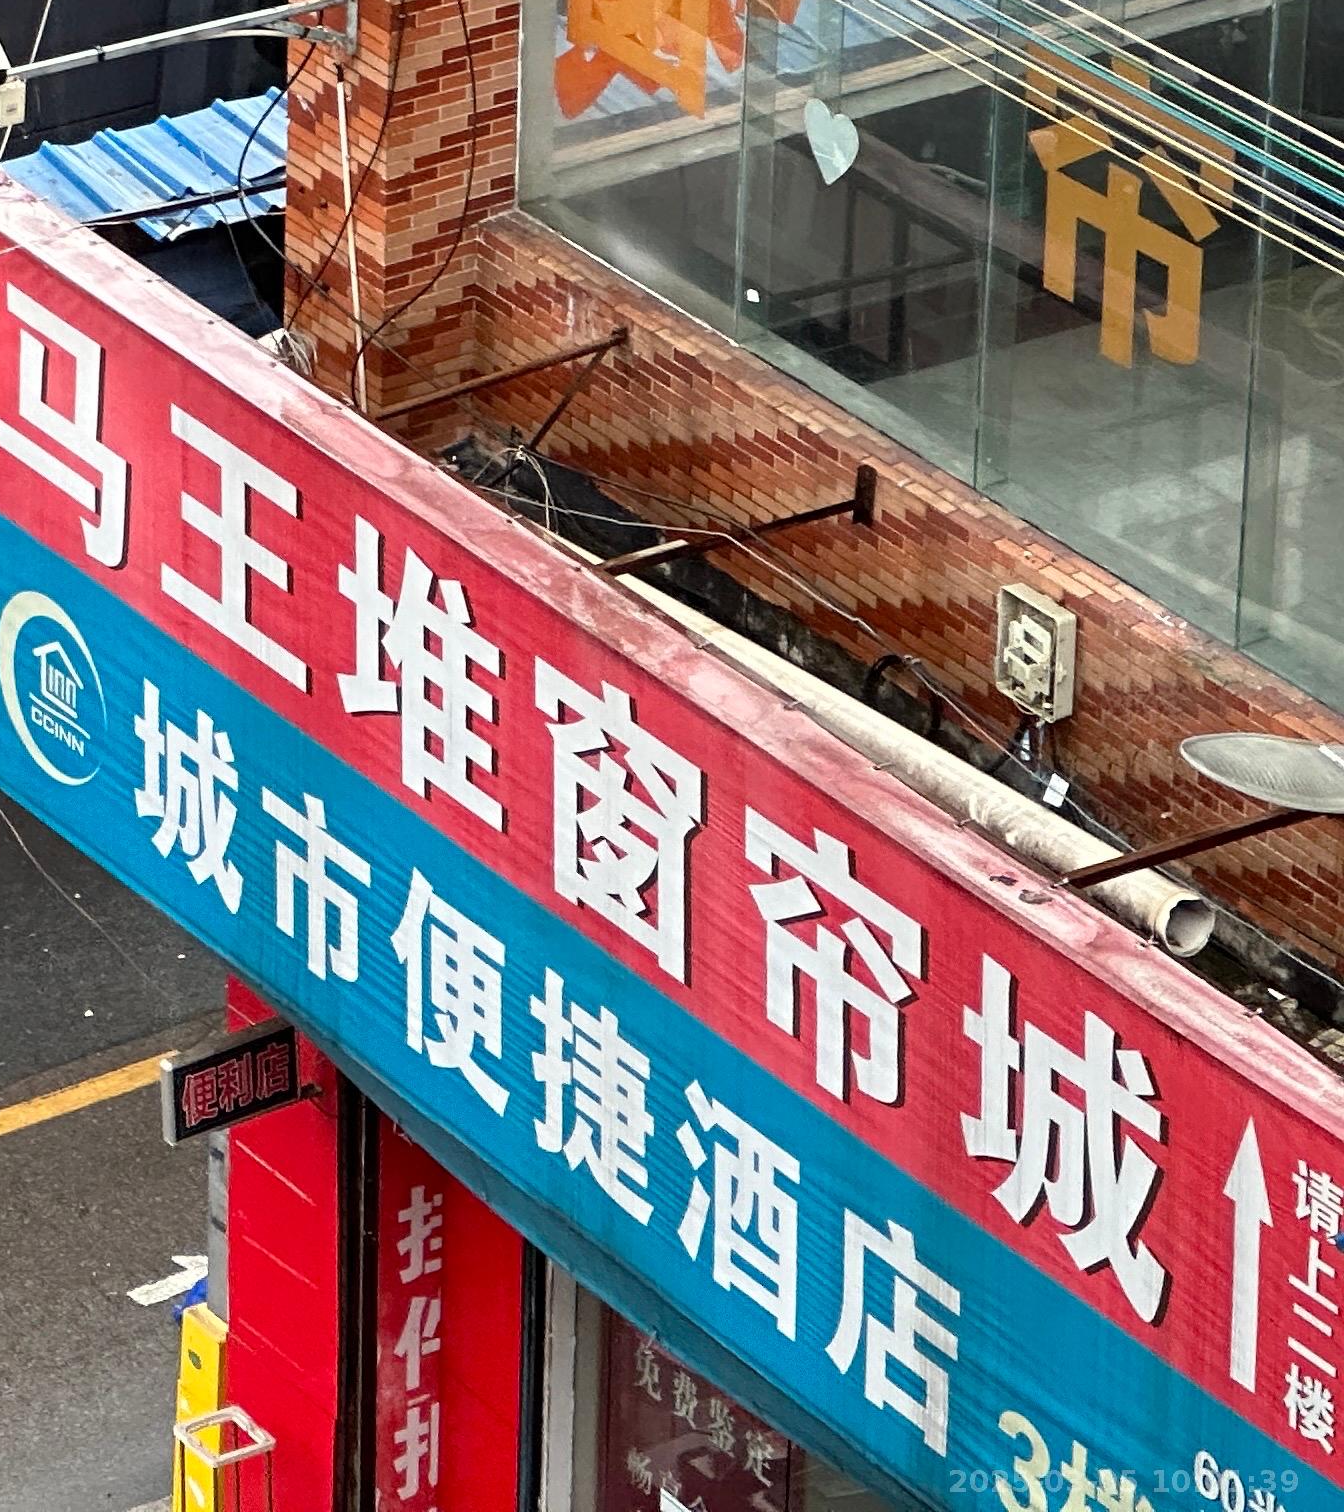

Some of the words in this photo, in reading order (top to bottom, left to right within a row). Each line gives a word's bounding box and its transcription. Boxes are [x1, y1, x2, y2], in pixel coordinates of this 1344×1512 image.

[31, 704, 84, 757] CCINN
[134, 678, 961, 1457] 城市便捷酒店
[182, 1042, 289, 1128] 便利店
[1284, 1158, 1344, 1455] 请上二楼
